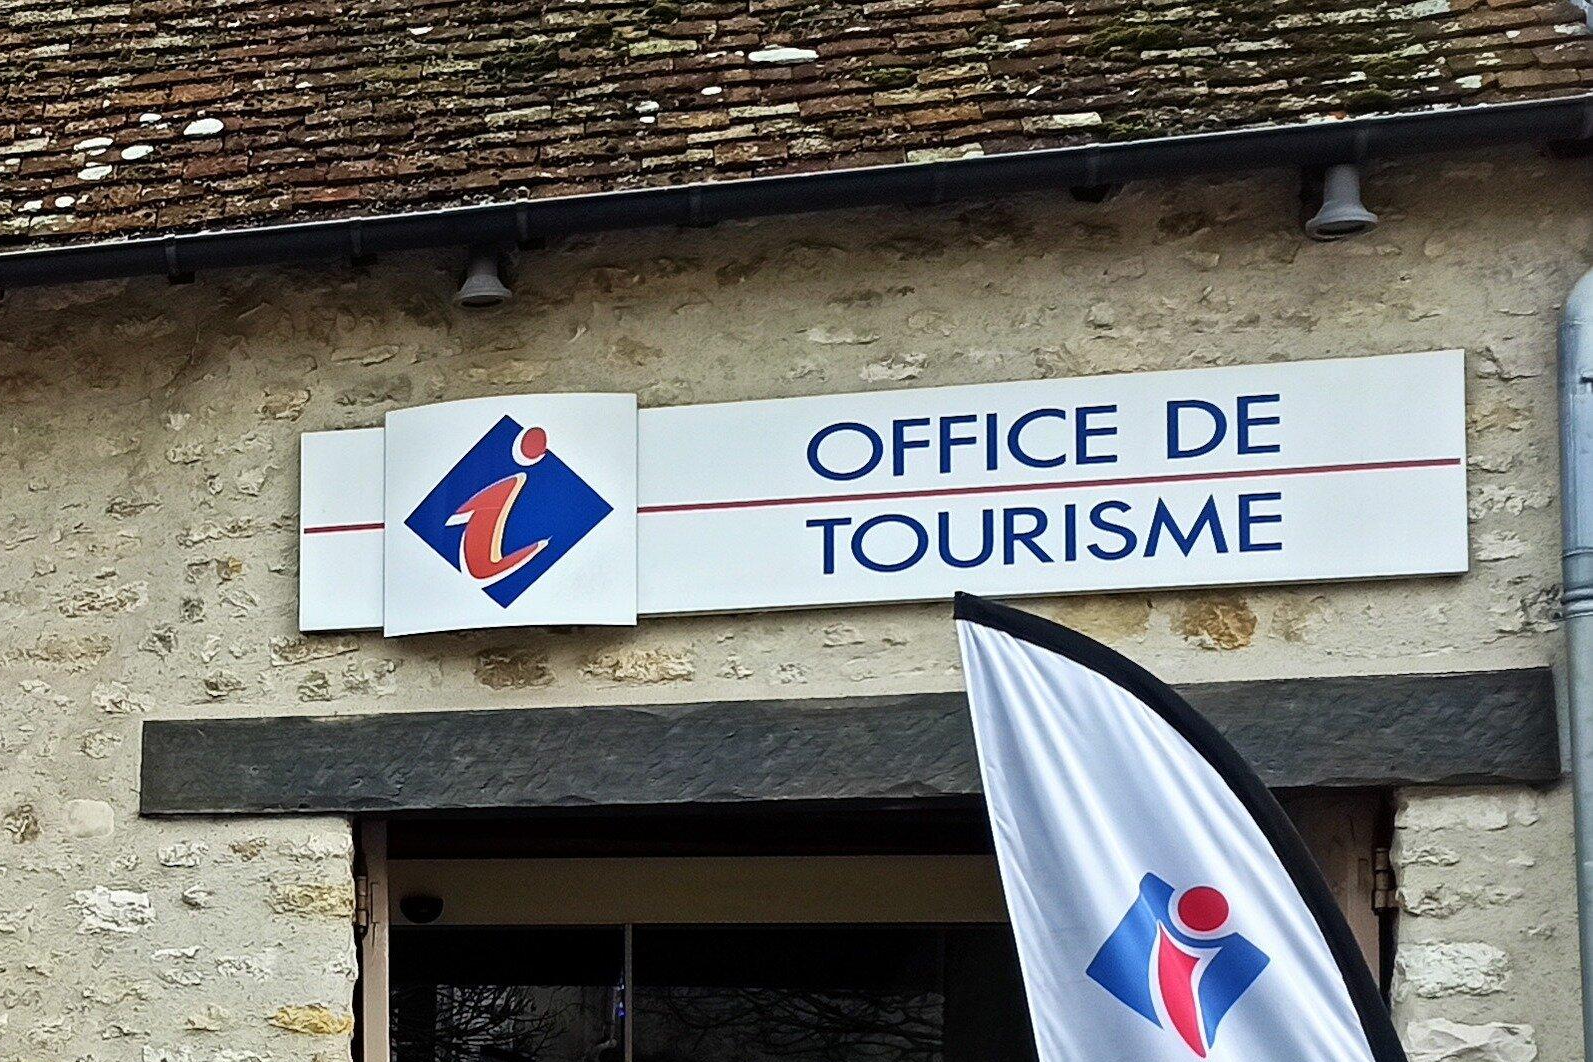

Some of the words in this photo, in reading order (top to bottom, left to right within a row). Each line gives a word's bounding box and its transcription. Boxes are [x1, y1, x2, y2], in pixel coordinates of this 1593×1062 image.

[806, 404, 1118, 482] OFFICE
[1166, 393, 1281, 460] DE
[805, 491, 1283, 575] TOURISME
